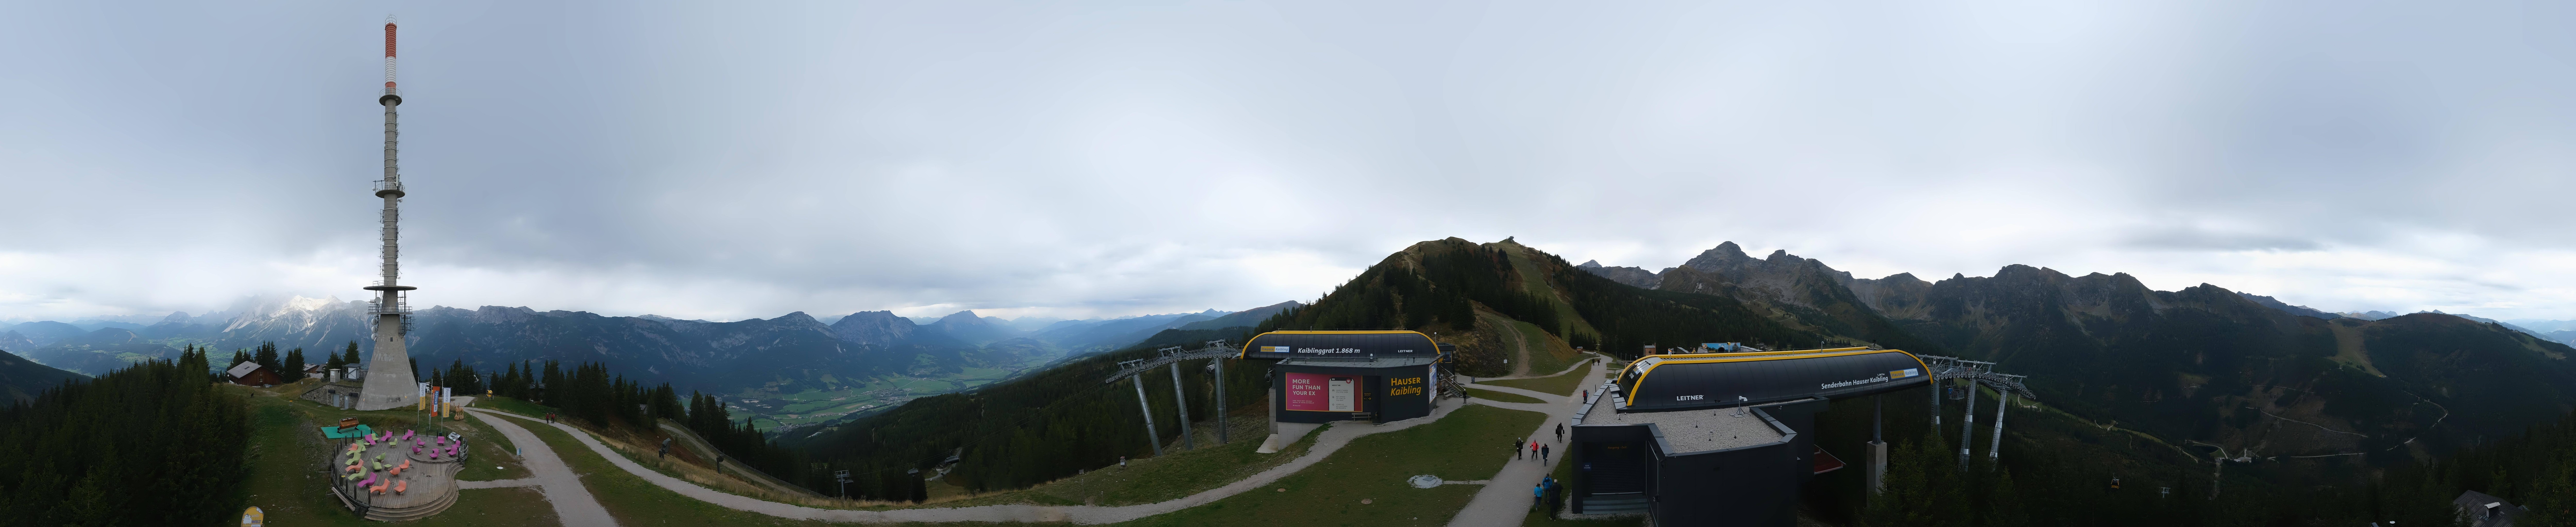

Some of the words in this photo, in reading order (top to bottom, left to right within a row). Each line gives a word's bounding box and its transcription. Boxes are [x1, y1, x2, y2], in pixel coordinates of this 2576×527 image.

[1391, 377, 1421, 386] HAUSER
[1821, 380, 1852, 389] Senderbahn
[1391, 386, 1421, 396] Kaibling
